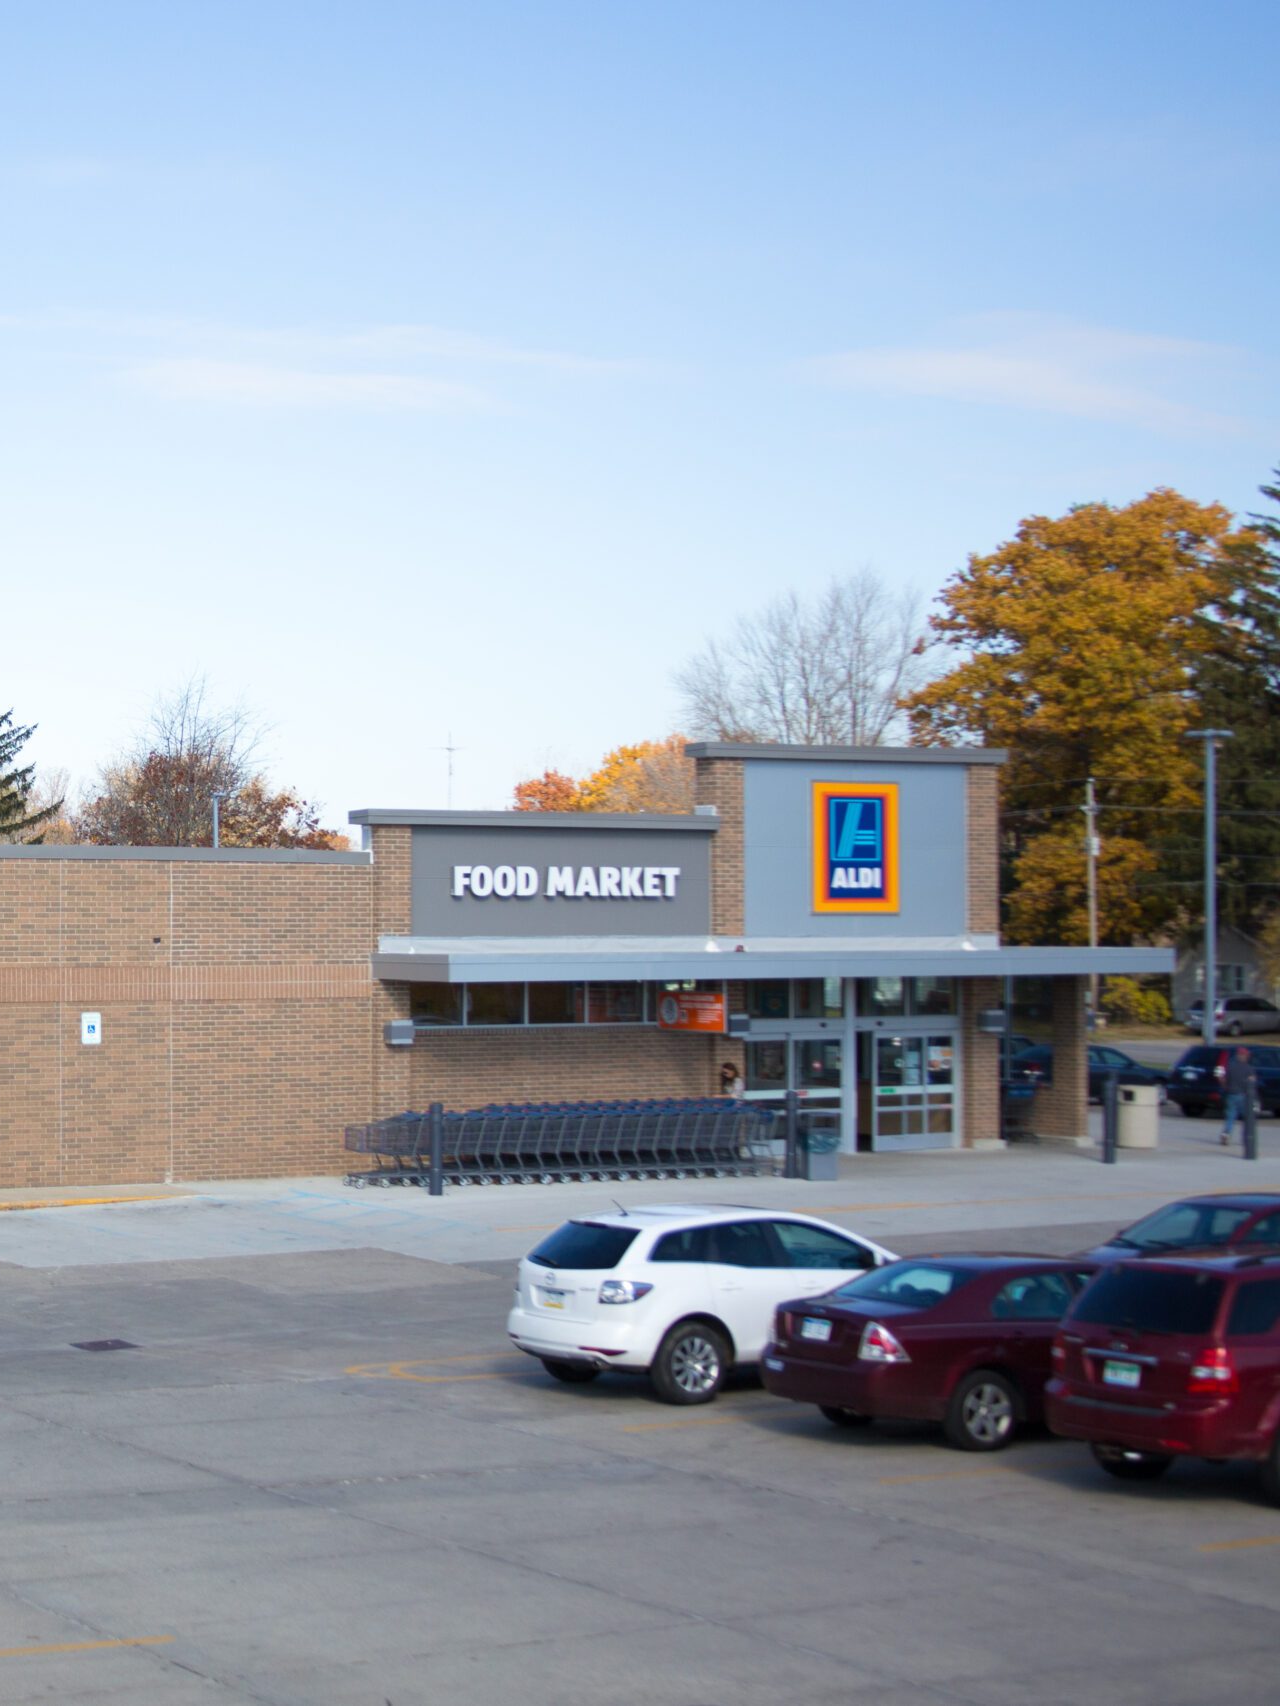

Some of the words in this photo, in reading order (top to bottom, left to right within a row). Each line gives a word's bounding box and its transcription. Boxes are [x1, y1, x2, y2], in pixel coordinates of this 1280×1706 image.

[453, 864, 539, 897] FOOD
[546, 866, 681, 897] MARKET
[830, 867, 883, 888] ALDI
